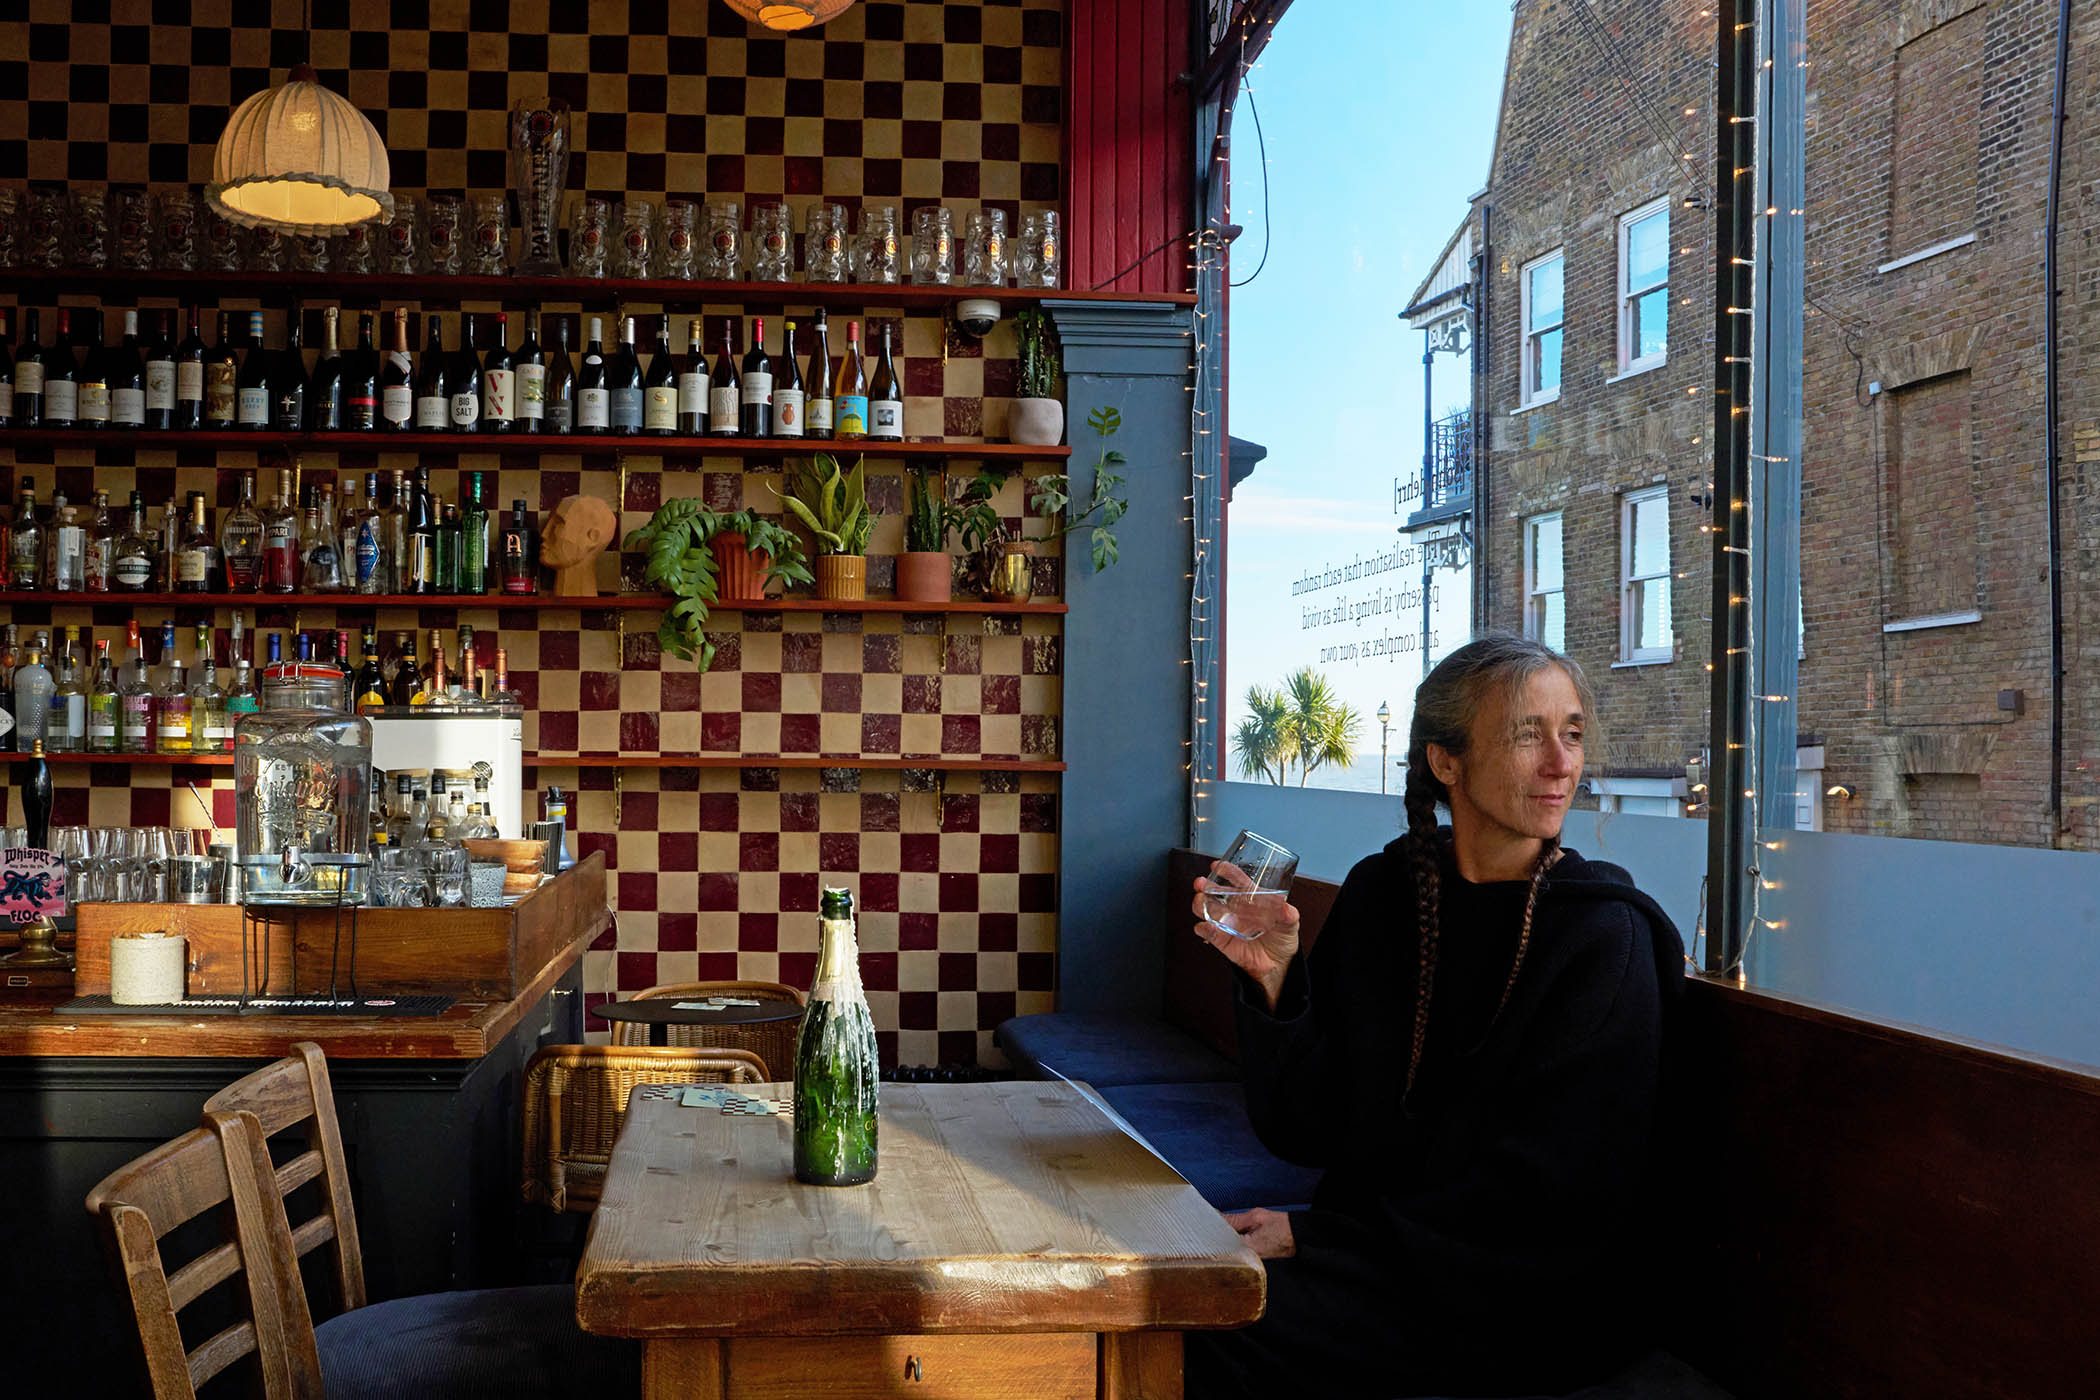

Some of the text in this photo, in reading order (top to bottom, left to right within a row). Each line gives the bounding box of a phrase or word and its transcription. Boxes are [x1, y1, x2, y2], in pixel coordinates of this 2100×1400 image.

[458, 397, 470, 406] BIG
[456, 407, 473, 417] SALT
[4, 847, 49, 865] Whisper
